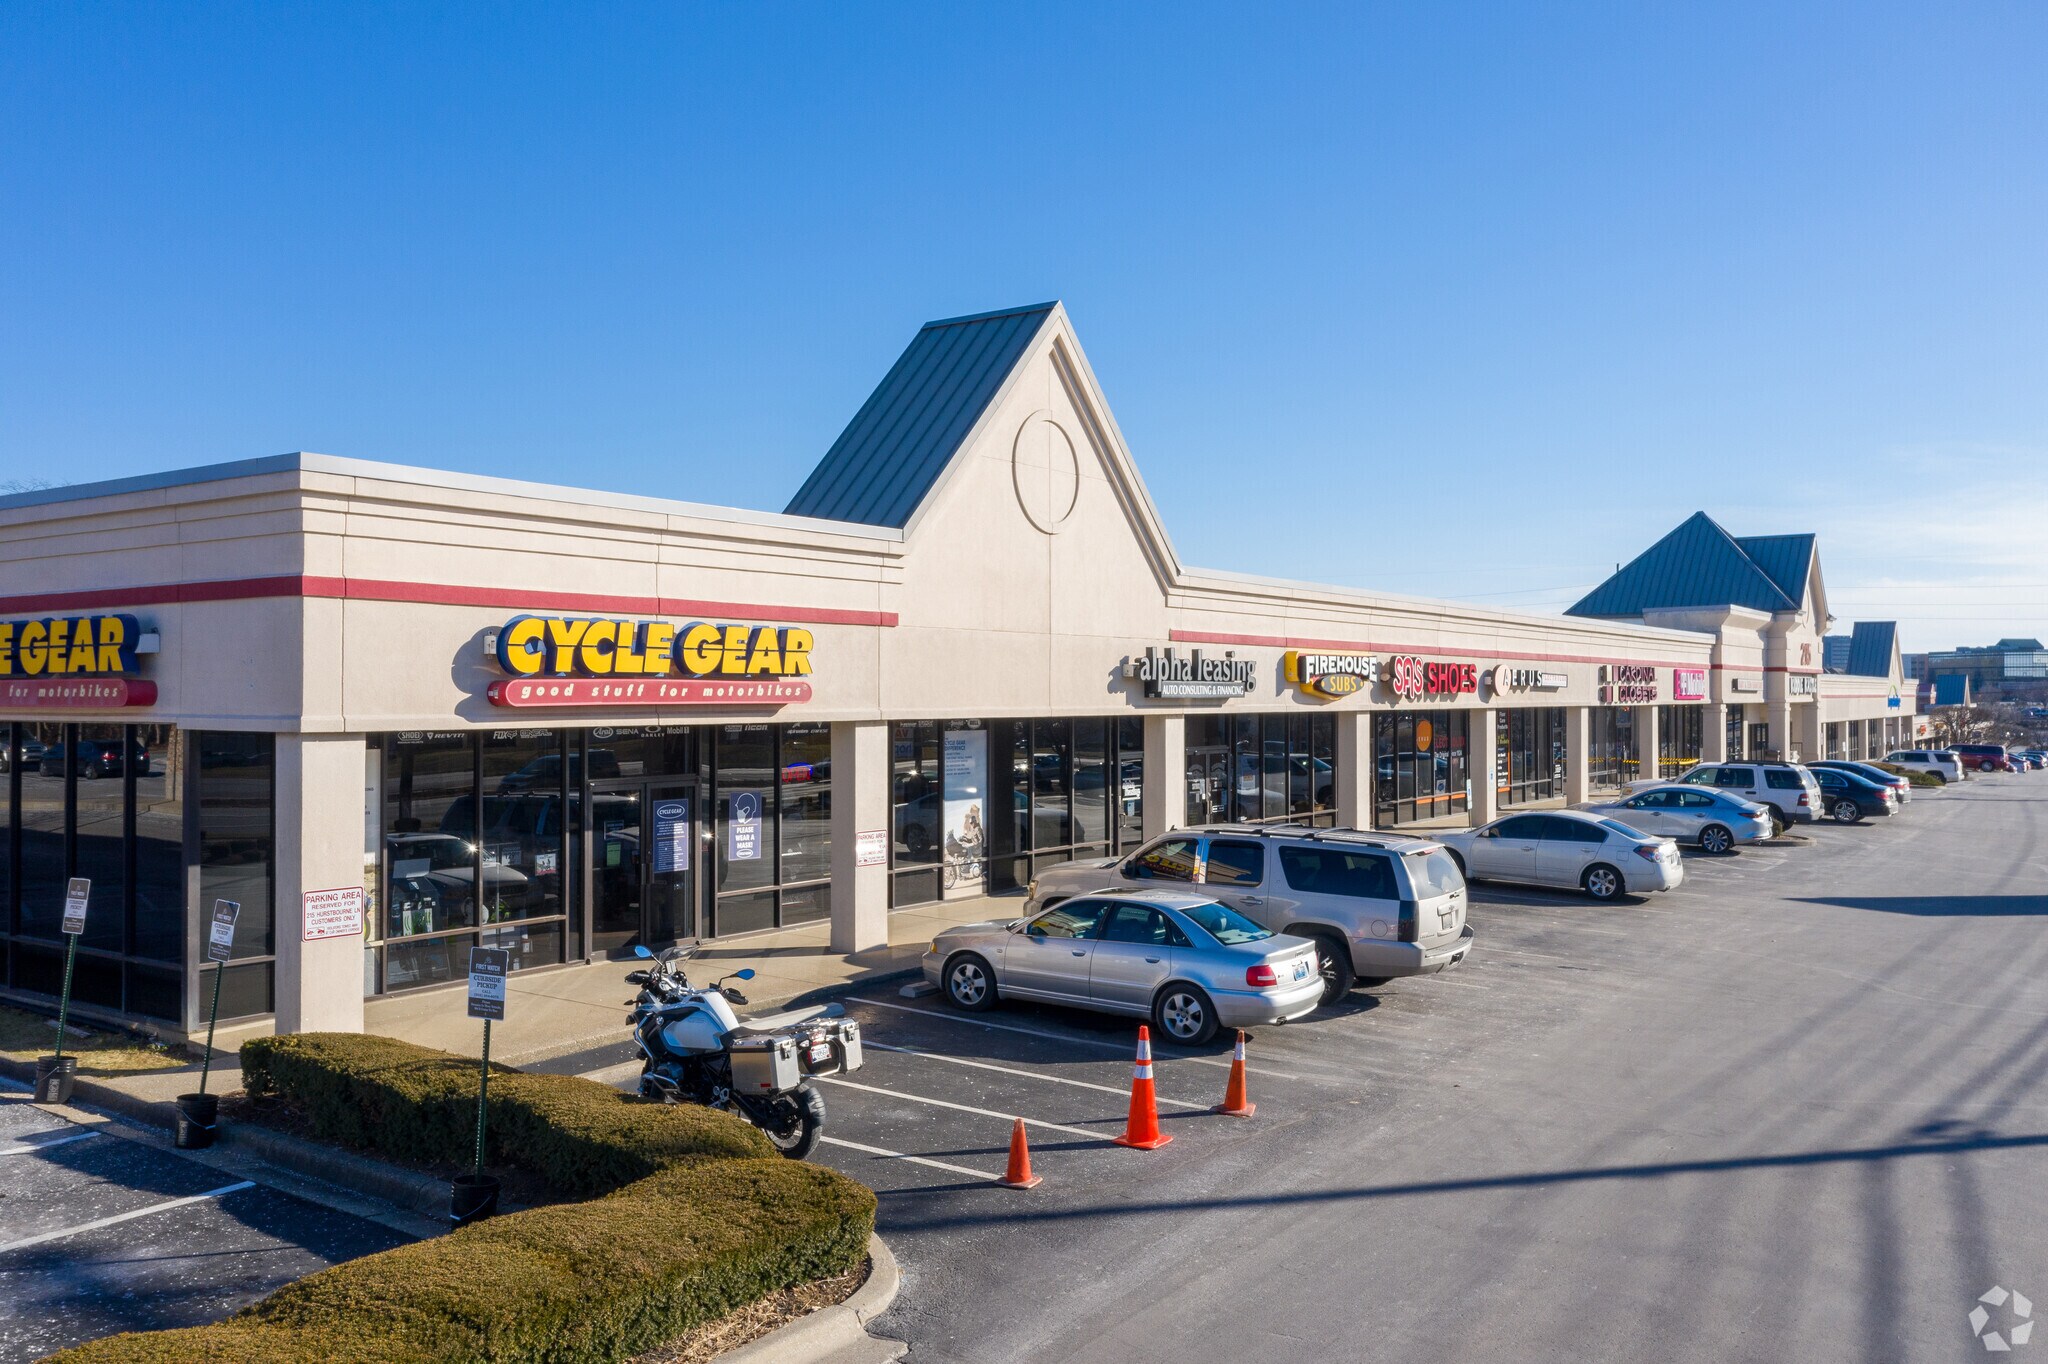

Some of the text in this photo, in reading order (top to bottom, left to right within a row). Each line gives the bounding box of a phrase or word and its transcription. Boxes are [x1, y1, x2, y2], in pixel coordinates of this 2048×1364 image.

[19, 617, 125, 675] GEAR
[507, 617, 815, 675] CYCLE GEAR
[1140, 646, 1257, 692] alpha leasing
[1305, 654, 1378, 684] FIREHOUSE
[1329, 675, 1357, 692] SUBS
[1392, 655, 1477, 699] SAS SHOES
[1502, 668, 1542, 687] AERUS
[9, 684, 118, 698] for motorbikes
[521, 683, 802, 699] good stuff for motorbikes
[1162, 684, 1244, 695] AUTO CONSULTING & FINANCING
[666, 726, 682, 734] Mobil
[736, 826, 754, 834] PLEASE
[735, 834, 748, 842] WEAR
[736, 841, 754, 849] MASK!
[306, 893, 338, 903] PARKING
[311, 917, 341, 925] CUSTOMERS
[473, 974, 501, 983] CURBSIDE
